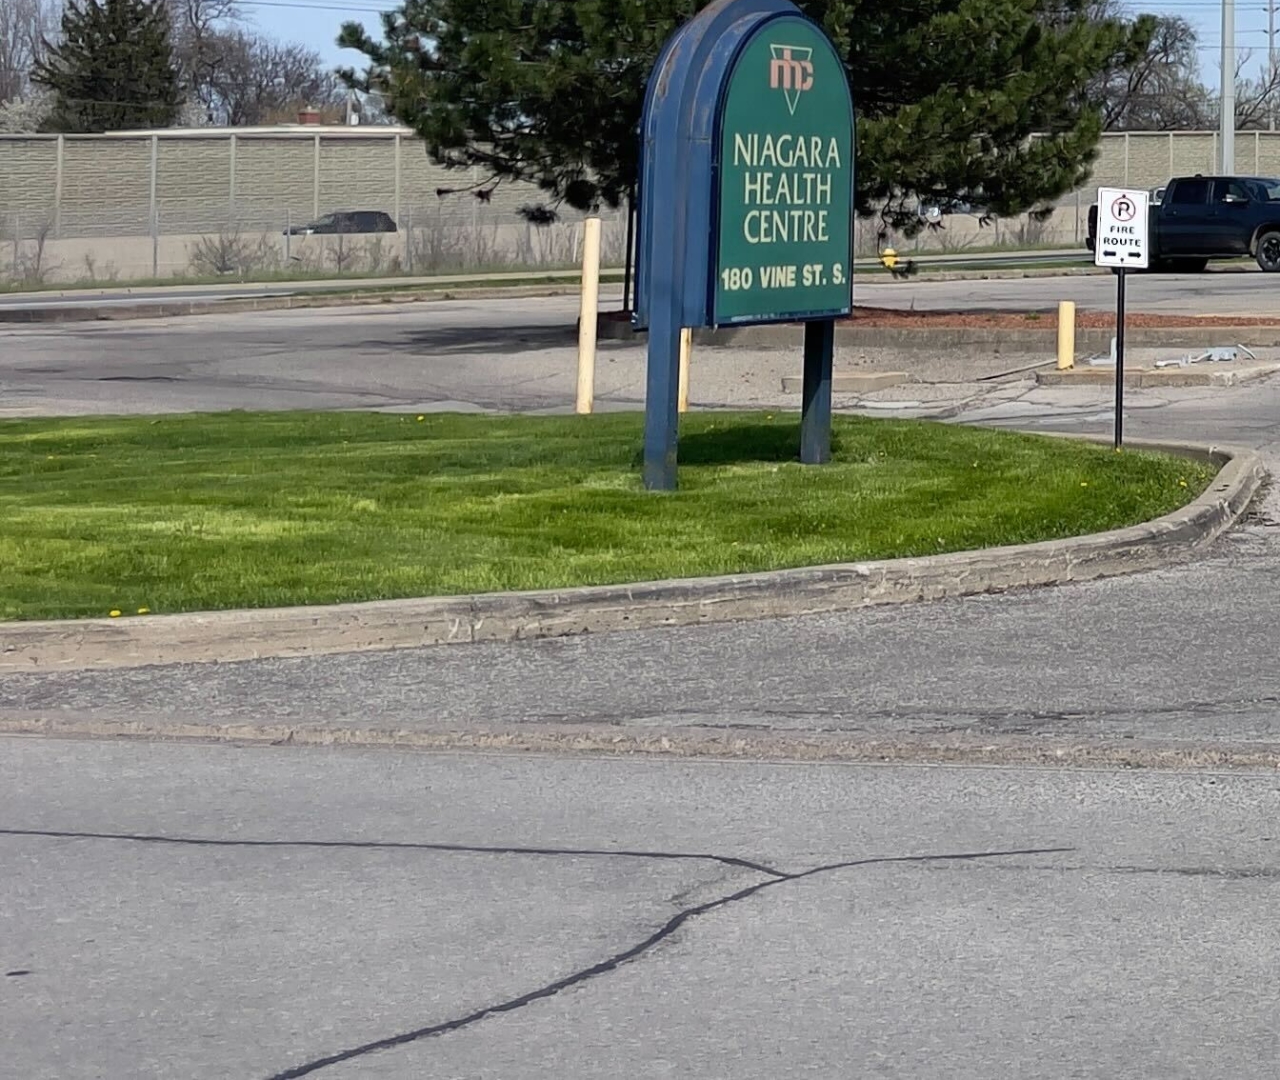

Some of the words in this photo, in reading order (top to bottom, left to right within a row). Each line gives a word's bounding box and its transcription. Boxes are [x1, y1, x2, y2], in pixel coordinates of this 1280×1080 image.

[733, 133, 841, 168] NIAGARA
[744, 171, 831, 205] HEALTH
[744, 209, 829, 244] CENTRE
[1103, 236, 1141, 248] ROUTE
[1110, 225, 1135, 234] FIRE
[721, 267, 753, 291] 180
[760, 265, 796, 289] VINE
[802, 264, 827, 287] ST.
[832, 263, 846, 285] S.
